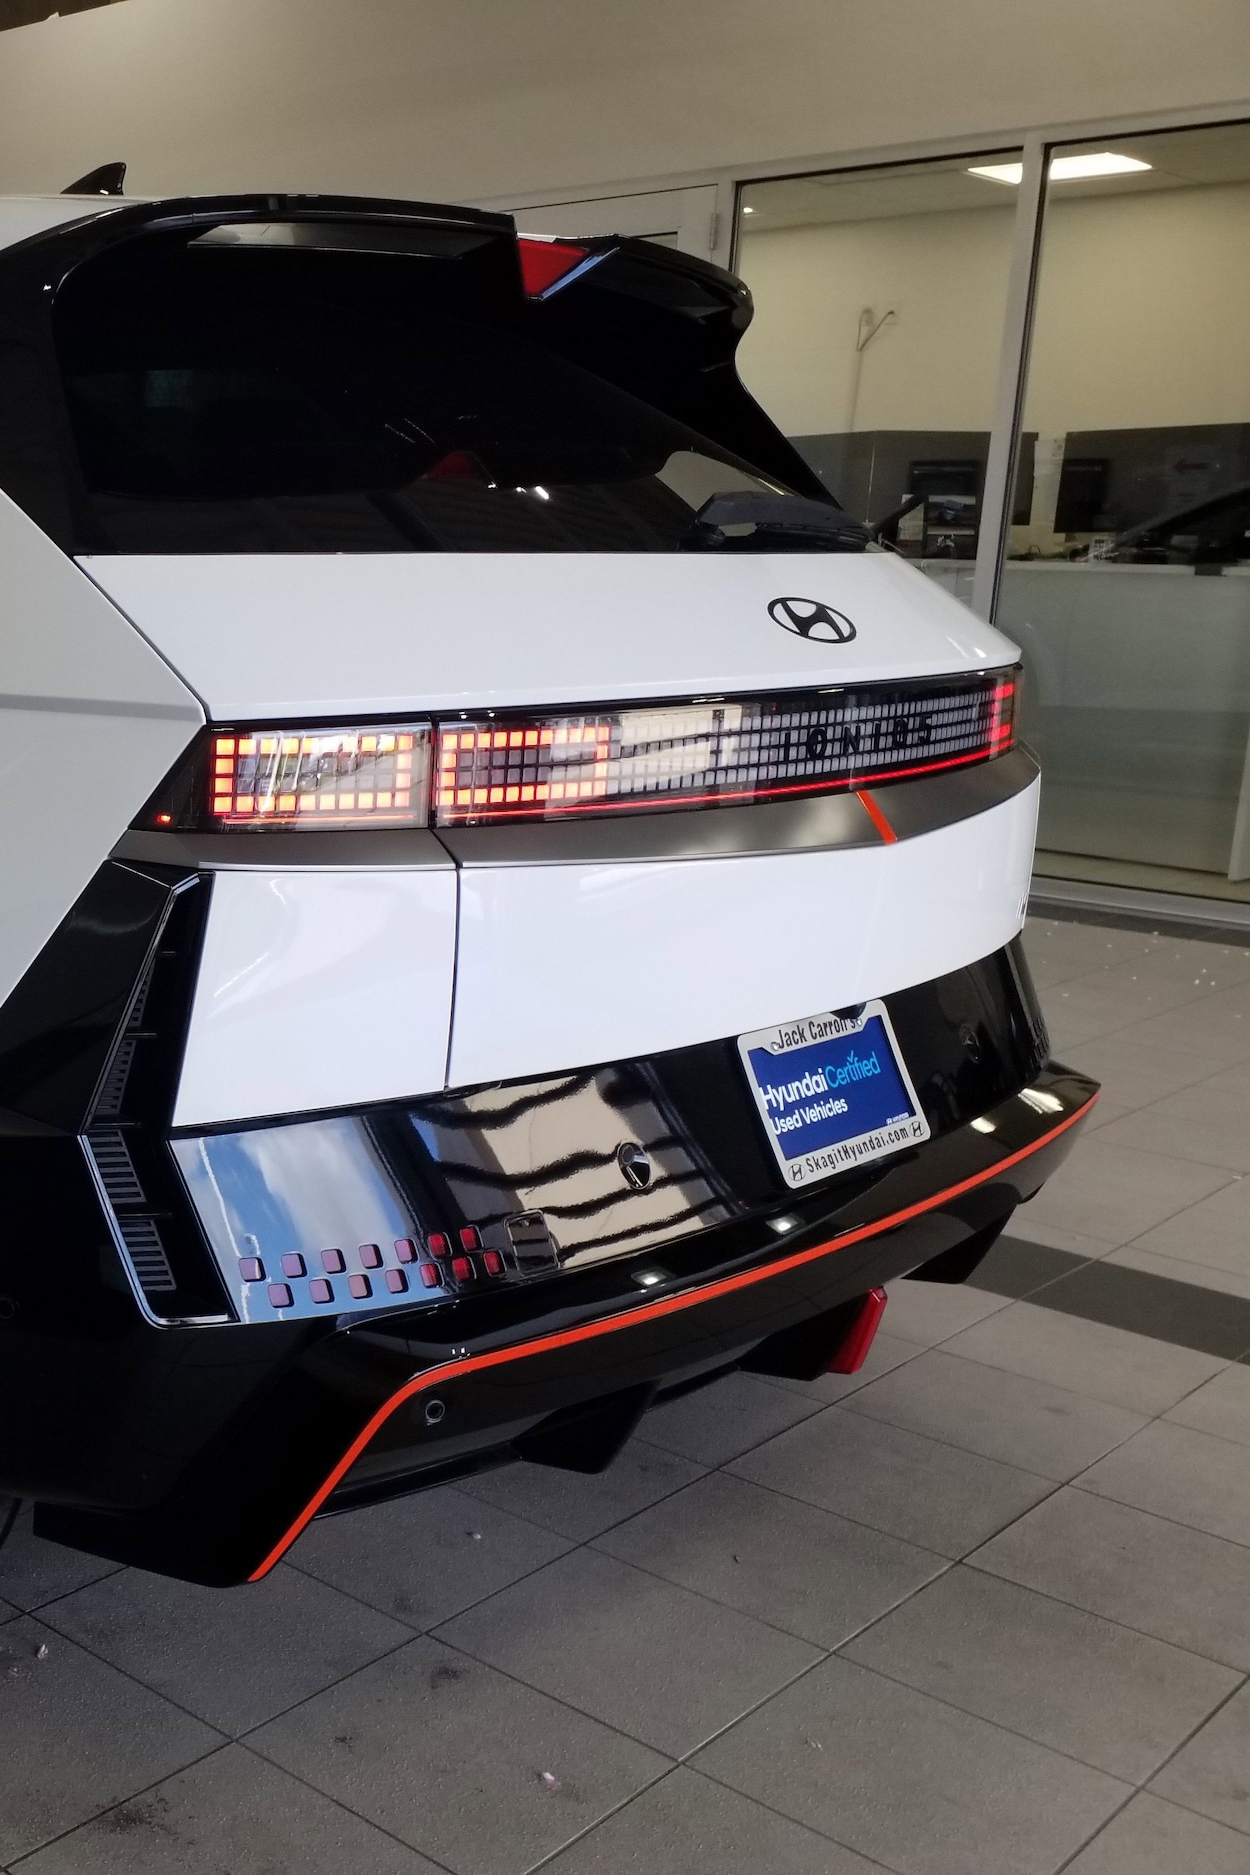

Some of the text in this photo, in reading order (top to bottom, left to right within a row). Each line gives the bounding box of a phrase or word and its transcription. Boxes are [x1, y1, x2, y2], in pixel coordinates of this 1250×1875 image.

[778, 1024, 807, 1049] Jack
[770, 1098, 848, 1135] Used Vehicles
[805, 1126, 909, 1173] SkagitHyundai.com
